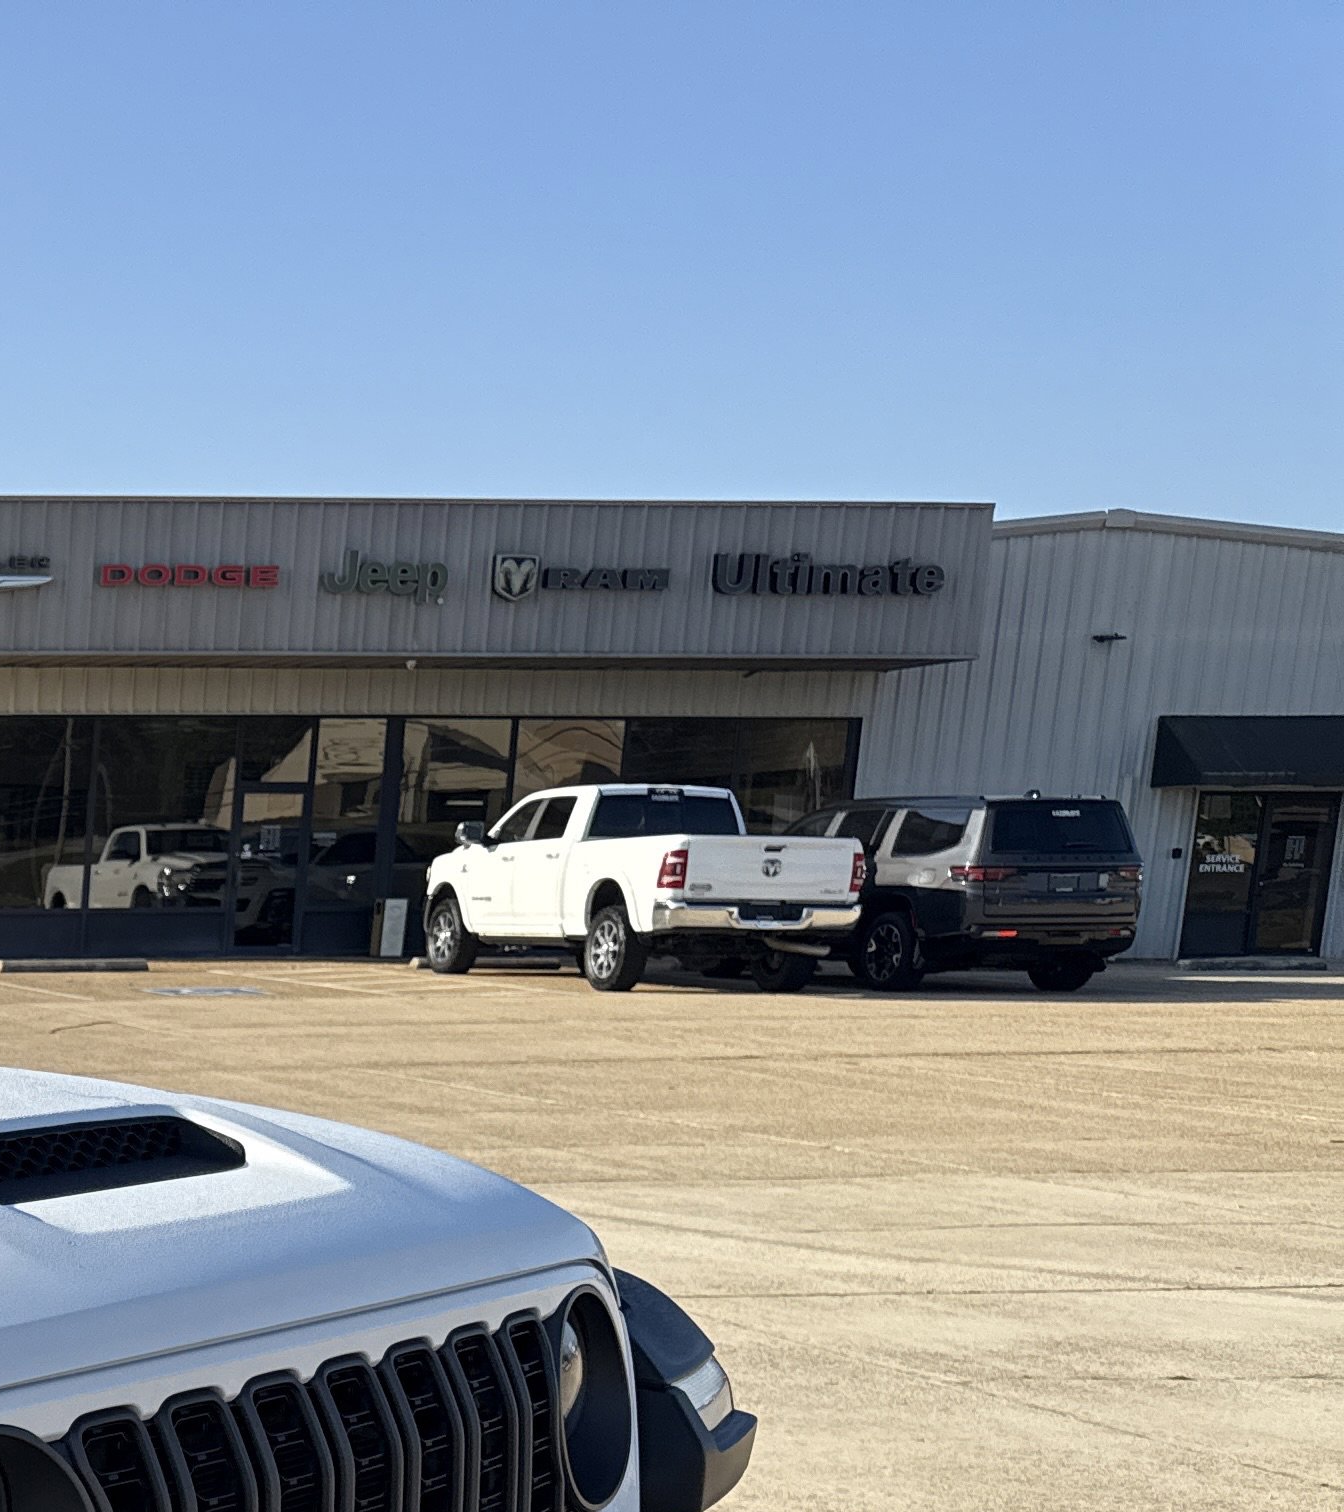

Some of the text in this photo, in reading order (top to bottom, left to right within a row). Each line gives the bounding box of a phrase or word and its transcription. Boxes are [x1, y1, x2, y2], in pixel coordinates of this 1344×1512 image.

[98, 563, 280, 588] DODGE
[317, 549, 449, 606] Jeep
[542, 566, 671, 591] RAM
[712, 552, 946, 597] Ultimate
[1198, 863, 1246, 873] ENTRANCE
[1205, 854, 1242, 863] SERVICE
